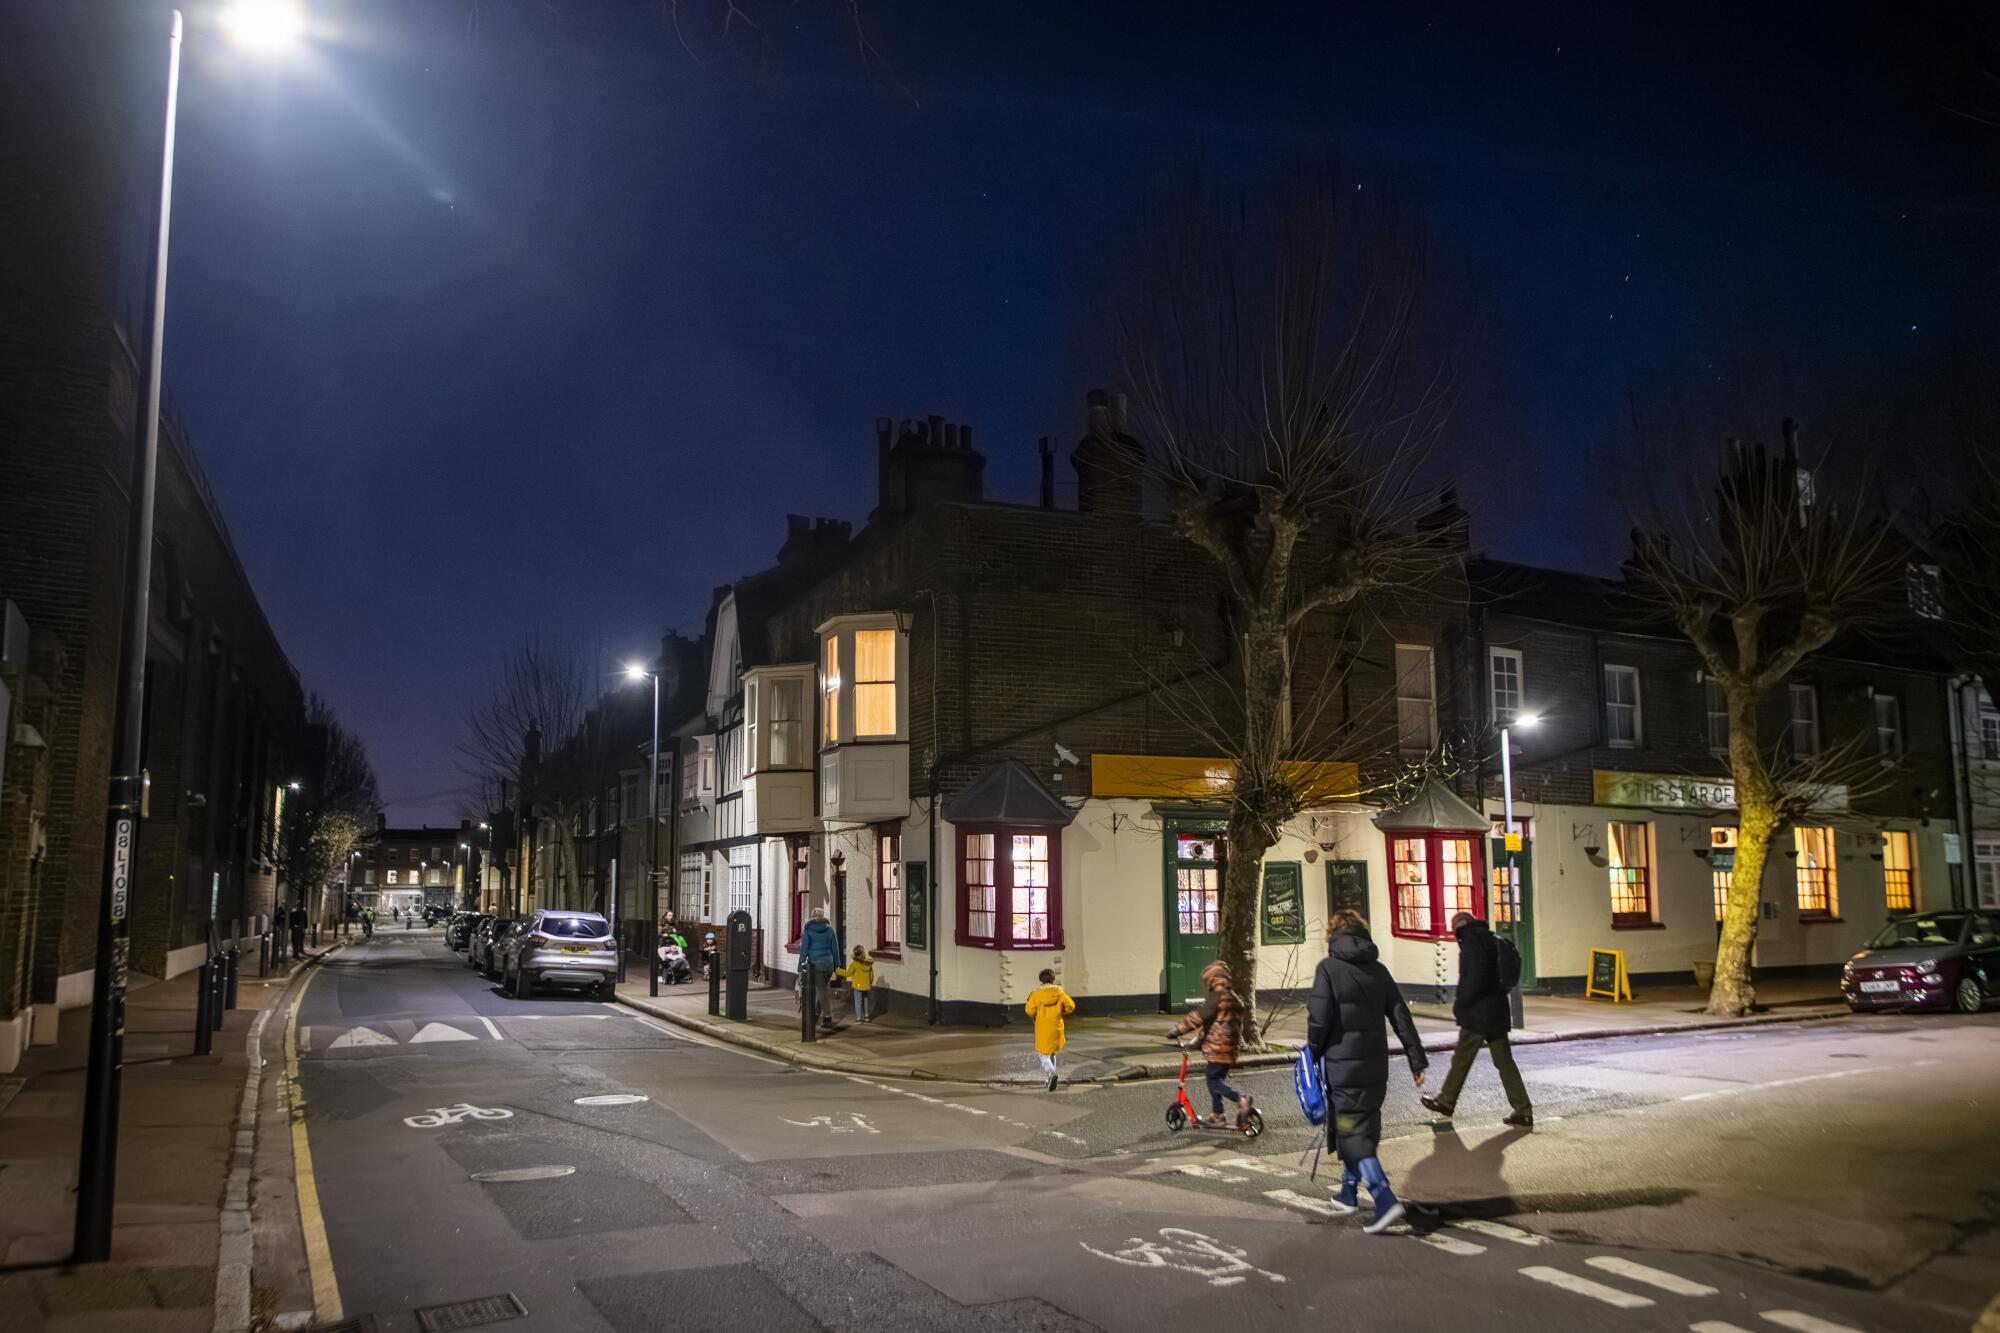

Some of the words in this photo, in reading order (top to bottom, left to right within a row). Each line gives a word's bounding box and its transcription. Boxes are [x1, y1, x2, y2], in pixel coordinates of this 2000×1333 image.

[1633, 782, 1663, 801] THE
[1668, 785, 1708, 803] STAR
[1713, 786, 1732, 804] OF
